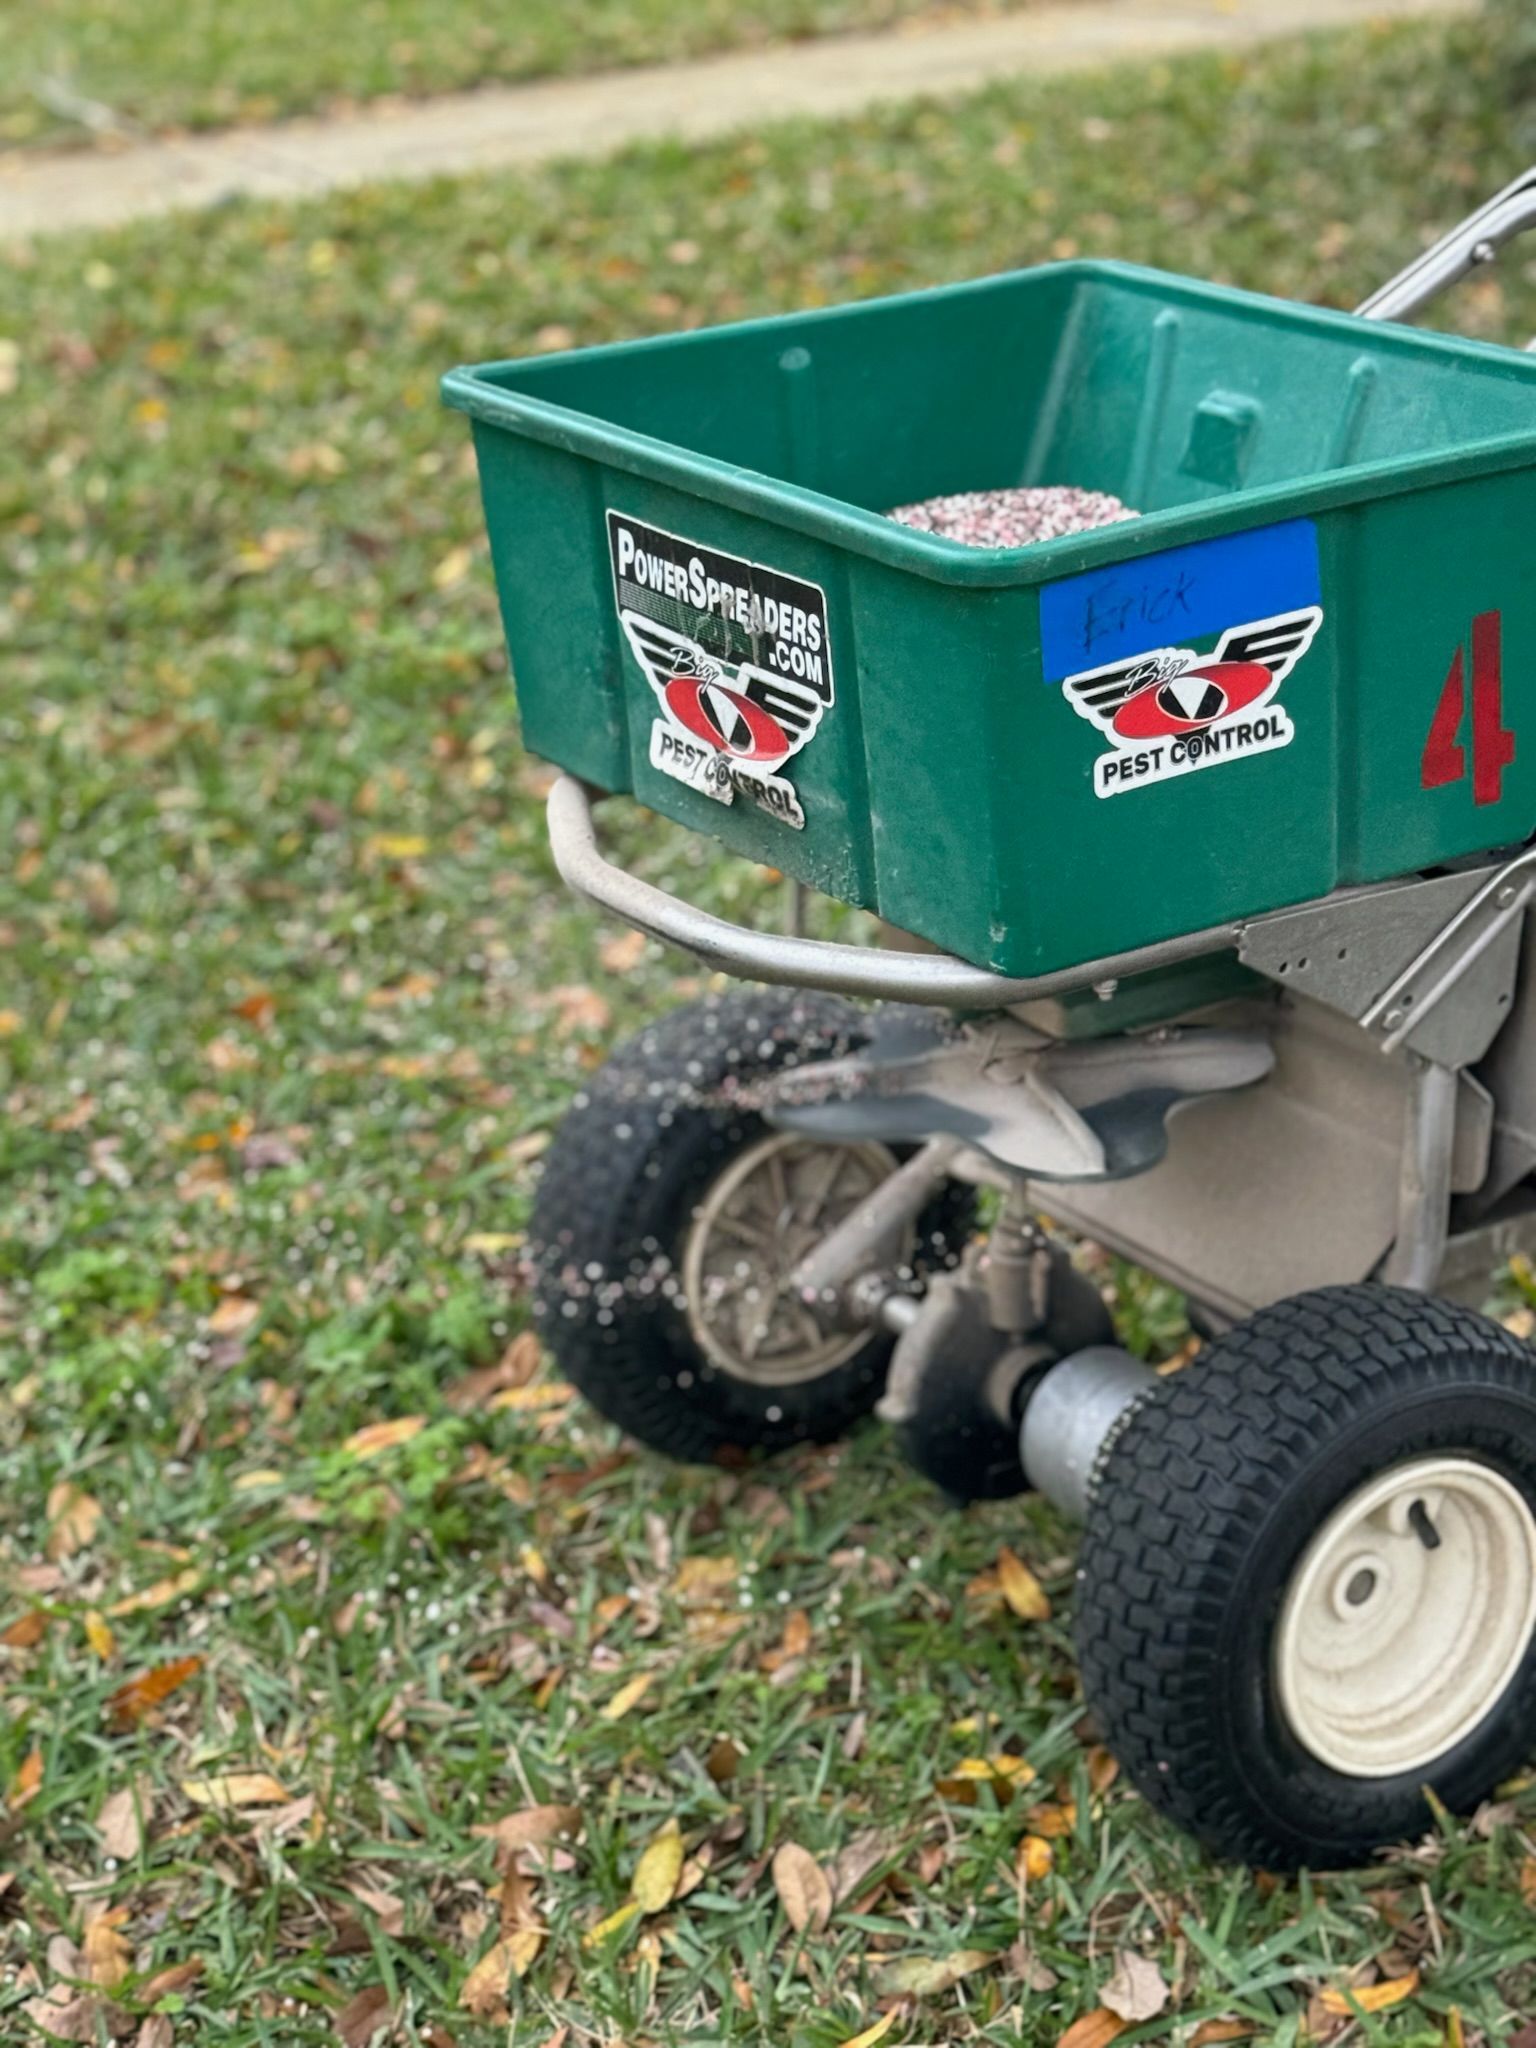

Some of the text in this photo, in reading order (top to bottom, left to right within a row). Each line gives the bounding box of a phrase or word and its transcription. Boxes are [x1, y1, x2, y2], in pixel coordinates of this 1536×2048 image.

[1083, 571, 1196, 655] Erick
[769, 643, 823, 685] .COM
[1124, 657, 1189, 699] Big
[1421, 608, 1516, 806] 4
[661, 733, 708, 778] PEST
[1103, 715, 1285, 785] PEST CONTROL
